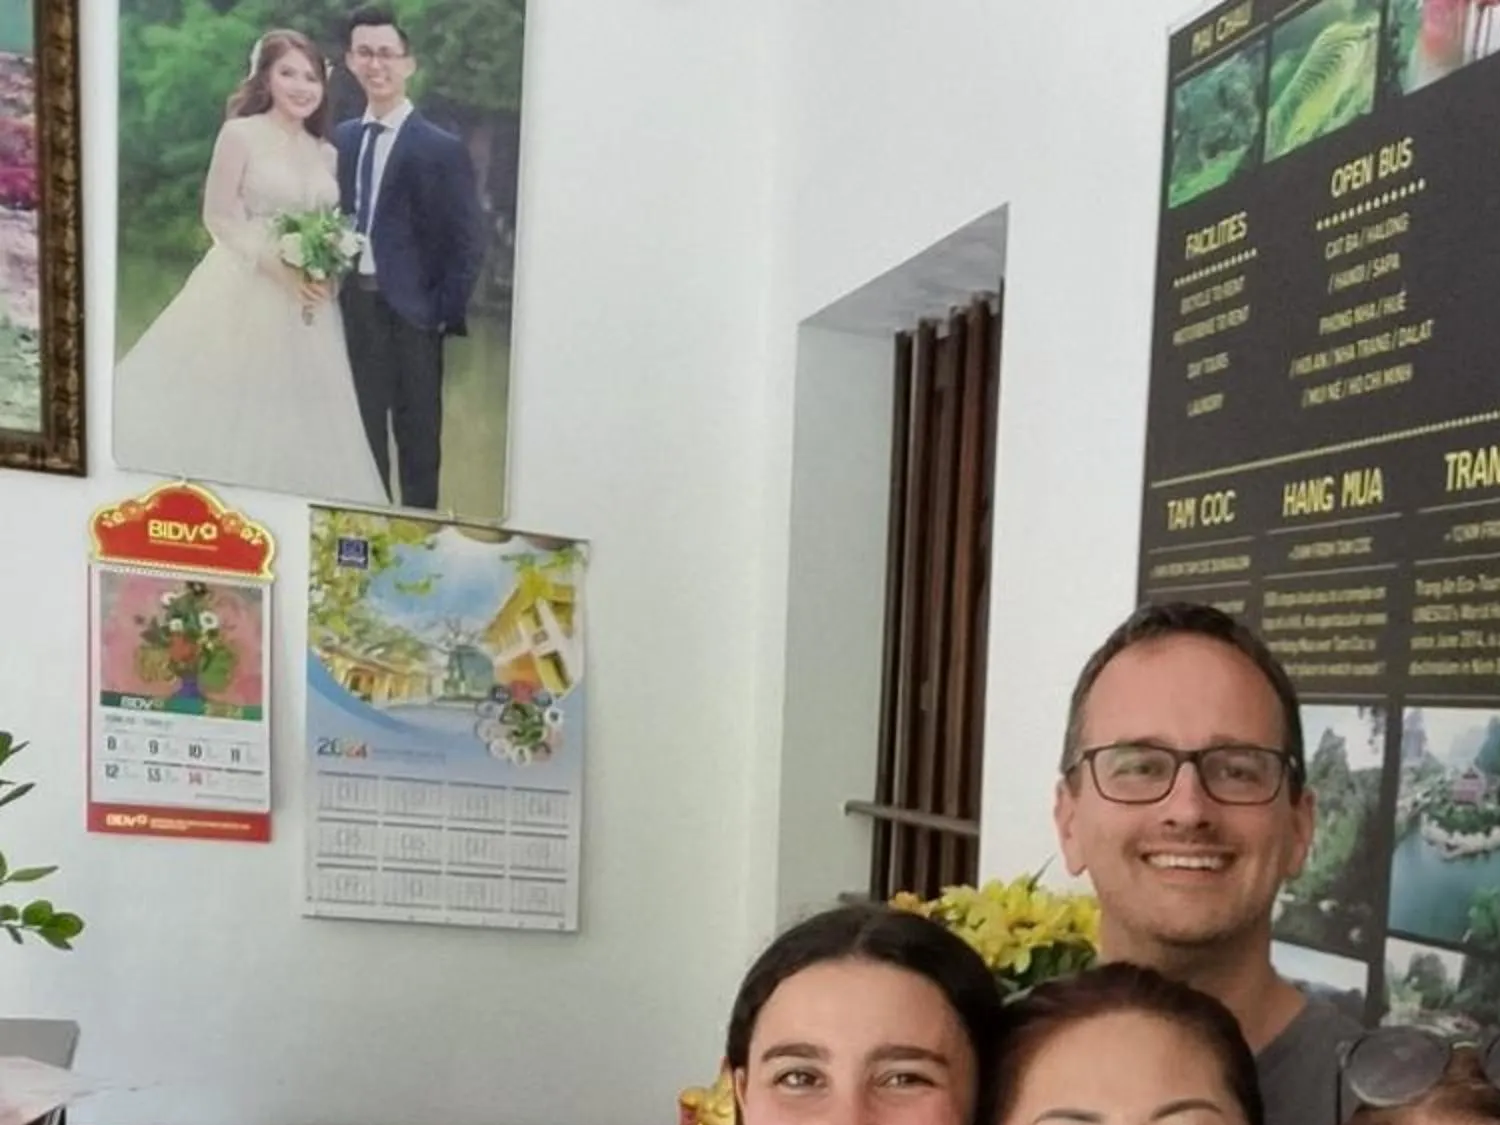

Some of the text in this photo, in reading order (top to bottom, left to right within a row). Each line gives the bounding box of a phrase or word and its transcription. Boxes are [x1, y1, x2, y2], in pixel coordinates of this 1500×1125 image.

[1331, 136, 1414, 198] OPEN BUS
[1282, 467, 1384, 517] HANG MUA
[1167, 490, 1236, 531] TAM COC
[148, 518, 199, 541] BIDV
[149, 739, 159, 755] 9
[188, 743, 203, 760] 10
[104, 763, 119, 780] 12
